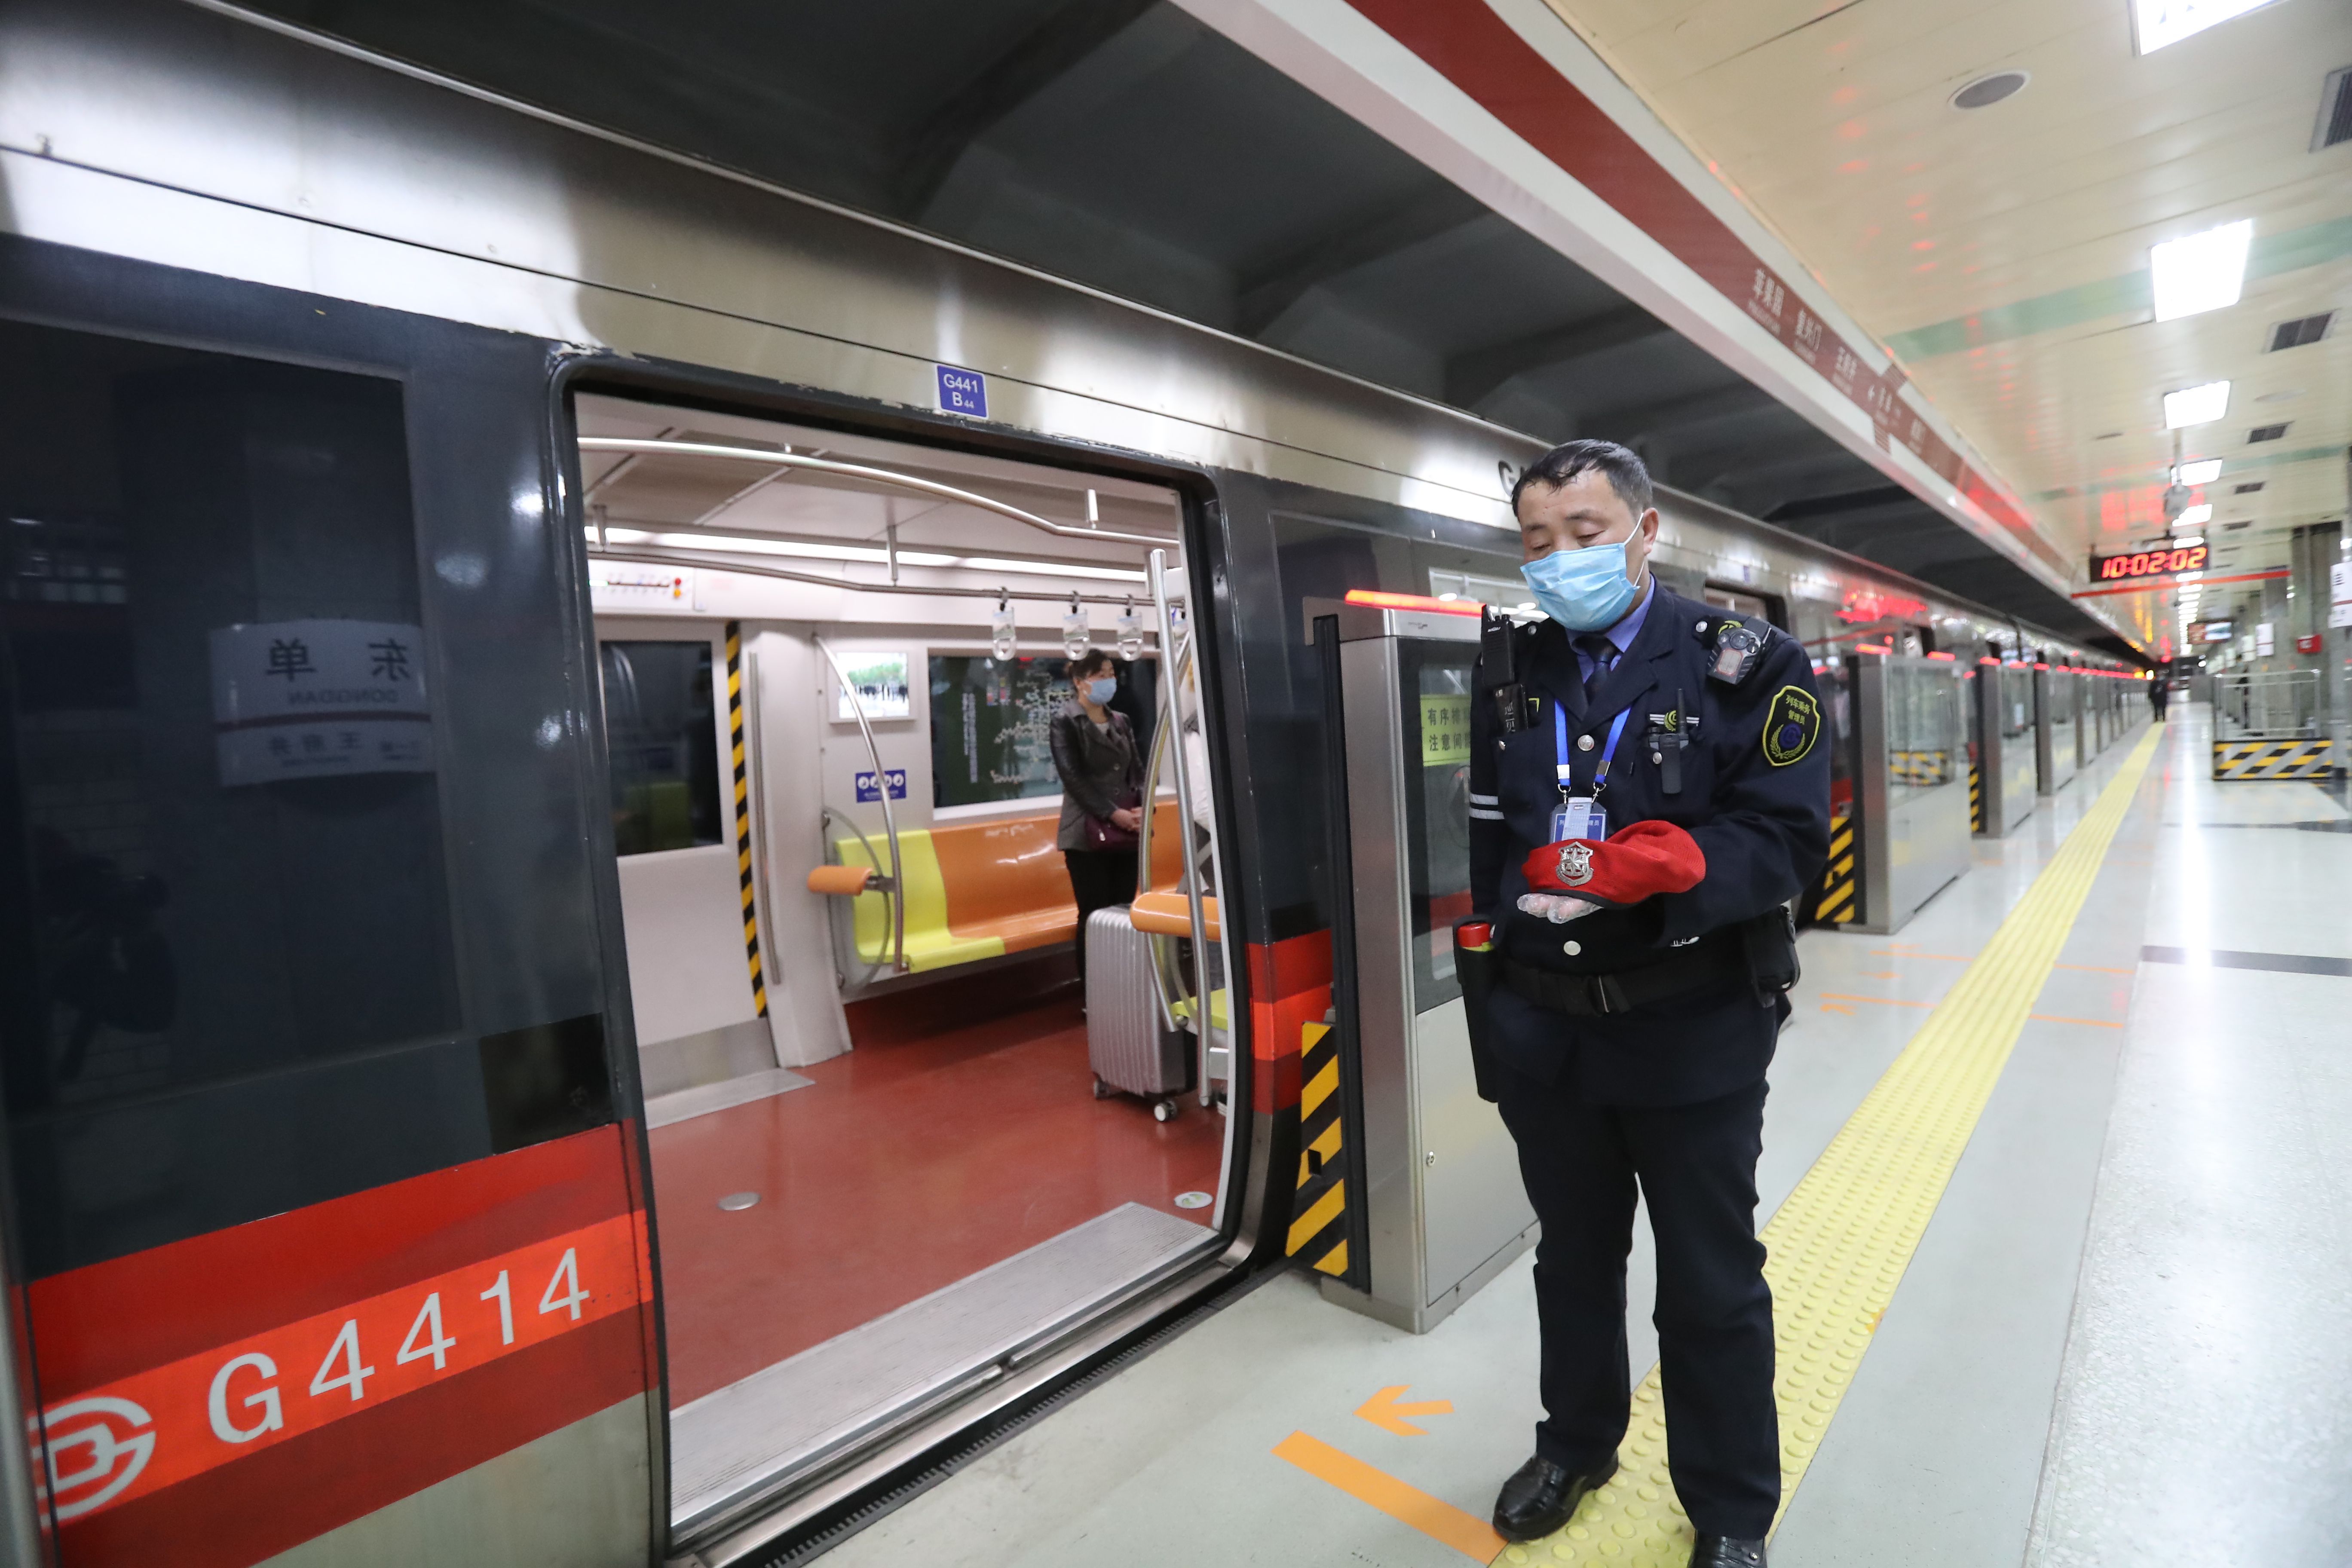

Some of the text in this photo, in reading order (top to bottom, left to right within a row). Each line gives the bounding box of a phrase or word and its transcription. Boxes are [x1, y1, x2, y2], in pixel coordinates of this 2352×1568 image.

[943, 373, 978, 394] G441
[2101, 547, 2208, 579] 10:02:02
[208, 1247, 590, 1444] G4414
